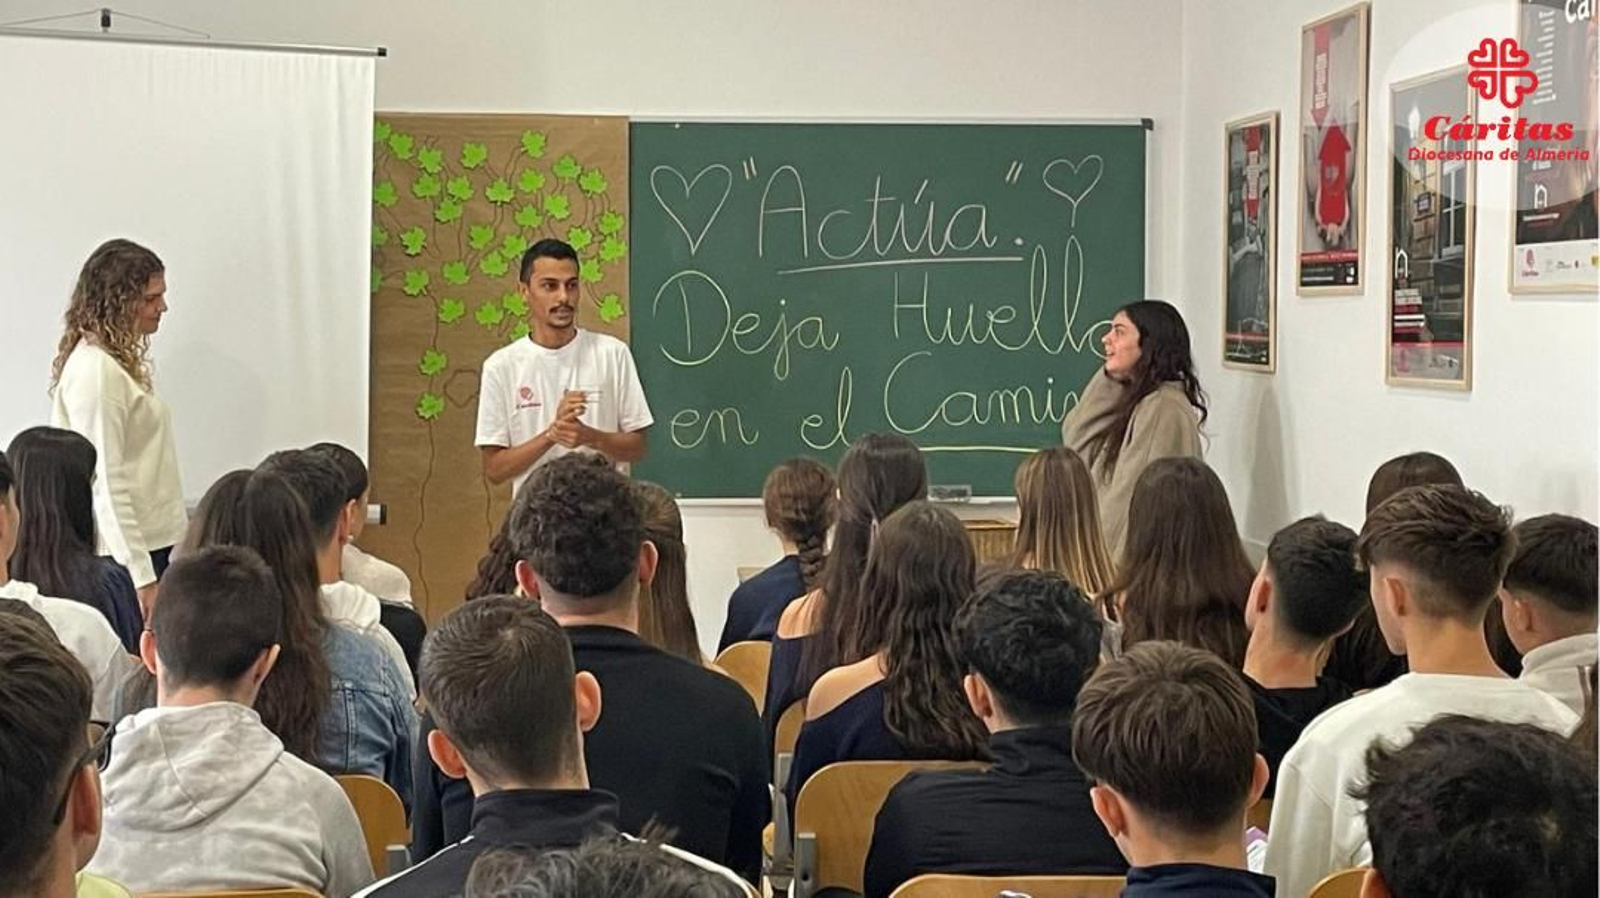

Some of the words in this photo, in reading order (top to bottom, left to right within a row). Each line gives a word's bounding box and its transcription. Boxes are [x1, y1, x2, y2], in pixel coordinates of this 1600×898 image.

[653, 269, 839, 381] Deja
[671, 406, 759, 449] en
[801, 366, 852, 450] el
[884, 350, 1081, 435] Camin
